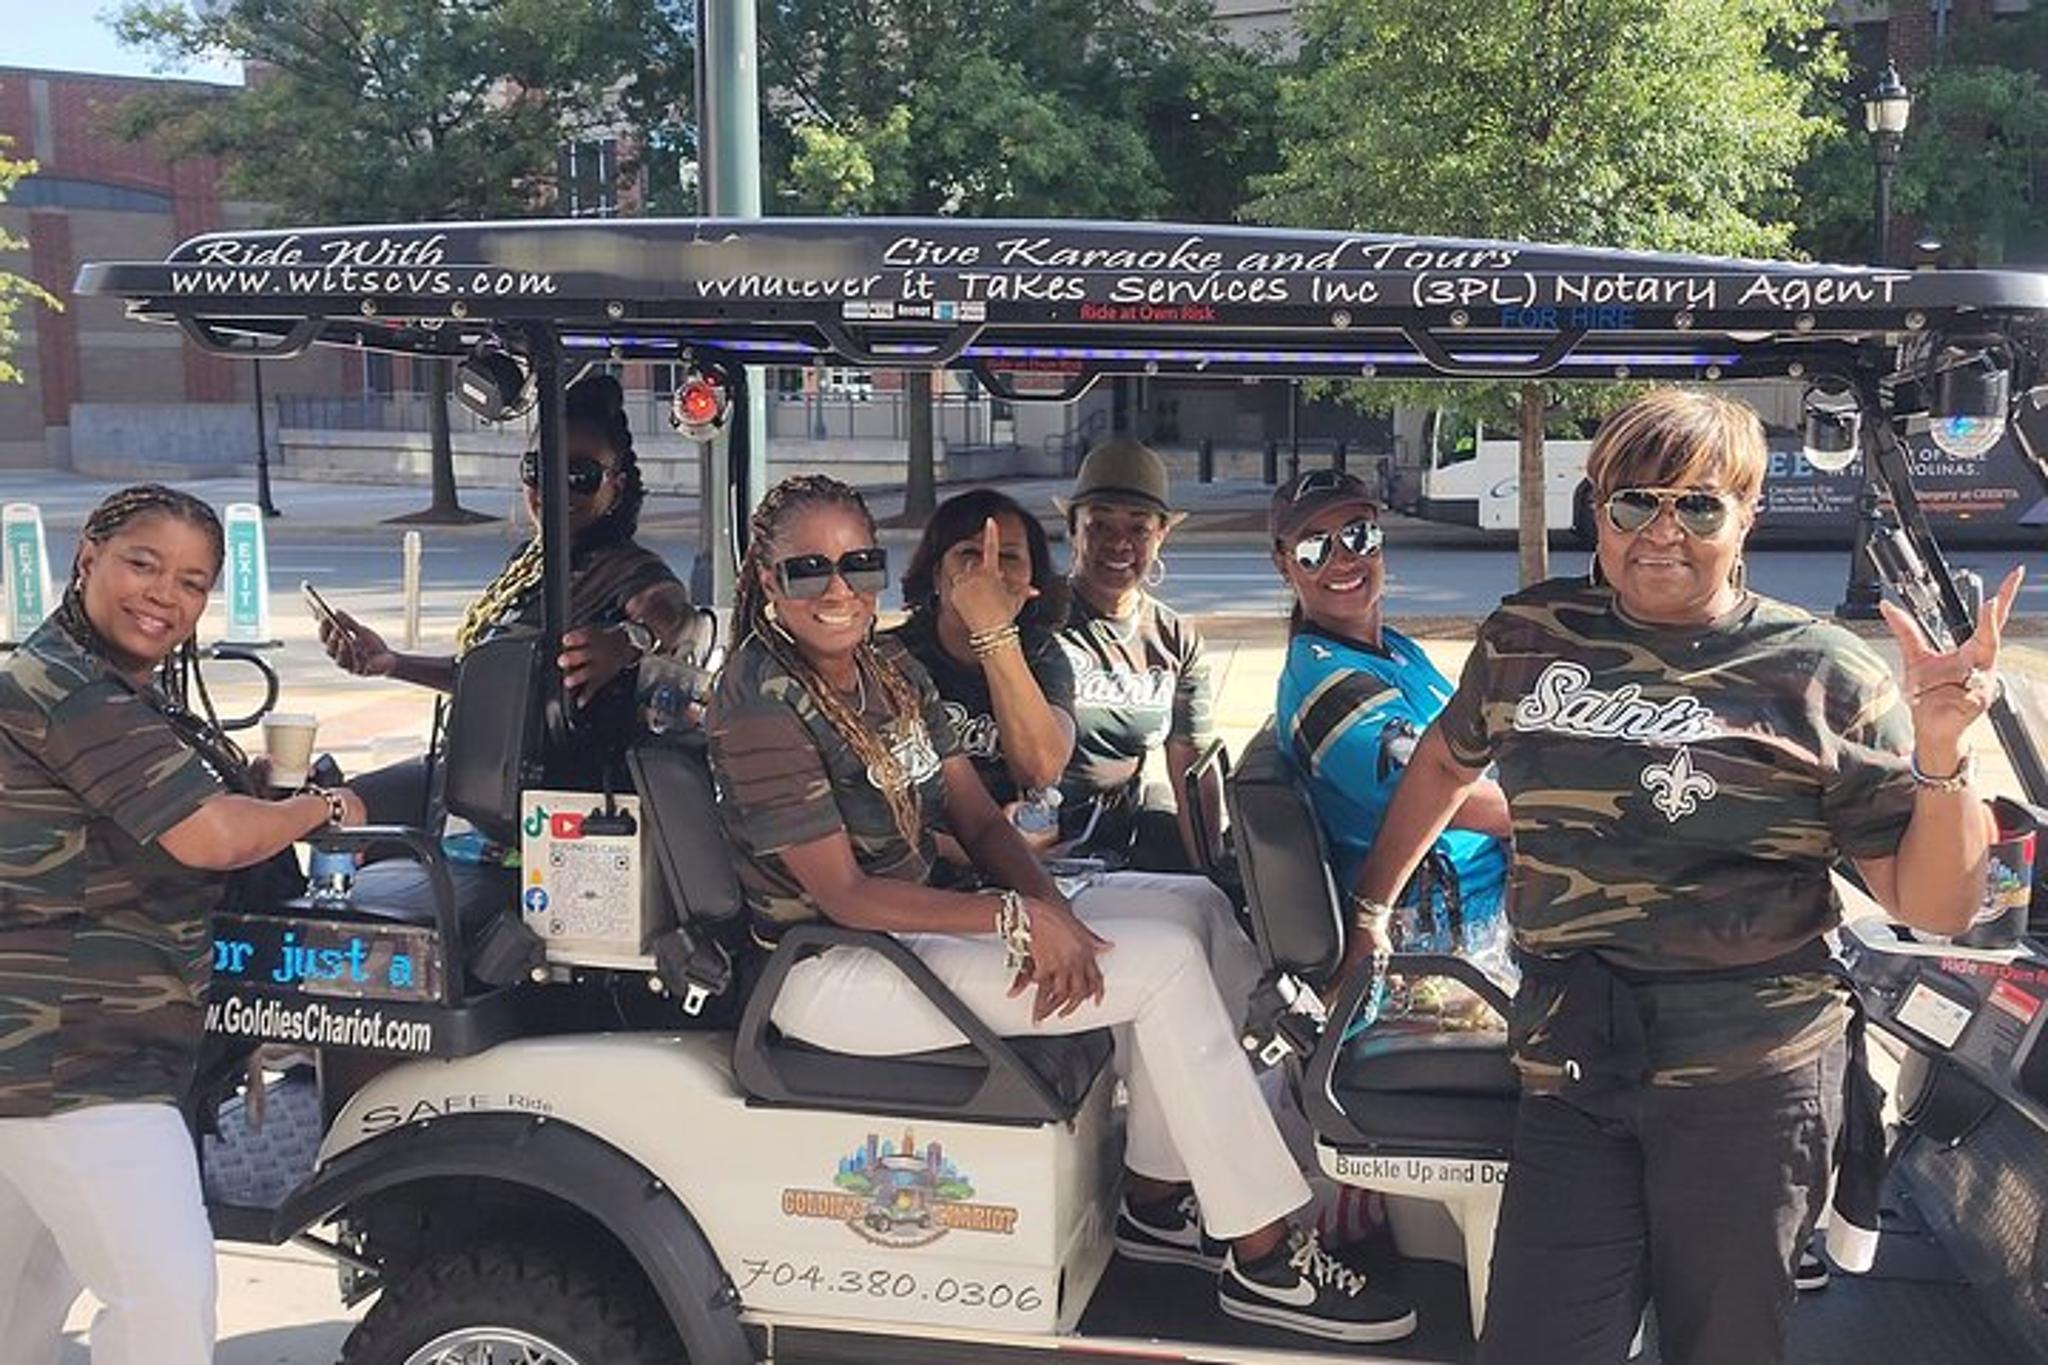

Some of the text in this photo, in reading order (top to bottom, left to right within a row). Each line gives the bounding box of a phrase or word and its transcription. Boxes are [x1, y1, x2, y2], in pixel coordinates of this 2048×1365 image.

[196, 233, 448, 267] Ride With
[883, 236, 1521, 272] Live Karaoke and Tours
[171, 266, 558, 296] www.witscvs.com
[903, 269, 935, 299] it
[1312, 276, 1379, 303] Inc
[1412, 272, 1537, 308] (3PL)
[1555, 273, 1716, 309] Notary
[1501, 306, 1637, 329] FOR HIRE
[18, 541, 35, 609] EXIT
[237, 541, 253, 608] EXIT
[1513, 660, 1722, 743] Saints
[272, 931, 371, 984] just
[388, 953, 413, 988] a
[361, 1093, 491, 1133] SAFE
[1335, 1156, 1400, 1178] Buckle
[1406, 1159, 1434, 1184] Up
[1438, 1163, 1475, 1183] and
[741, 1258, 1043, 1312] 704.380.0306
